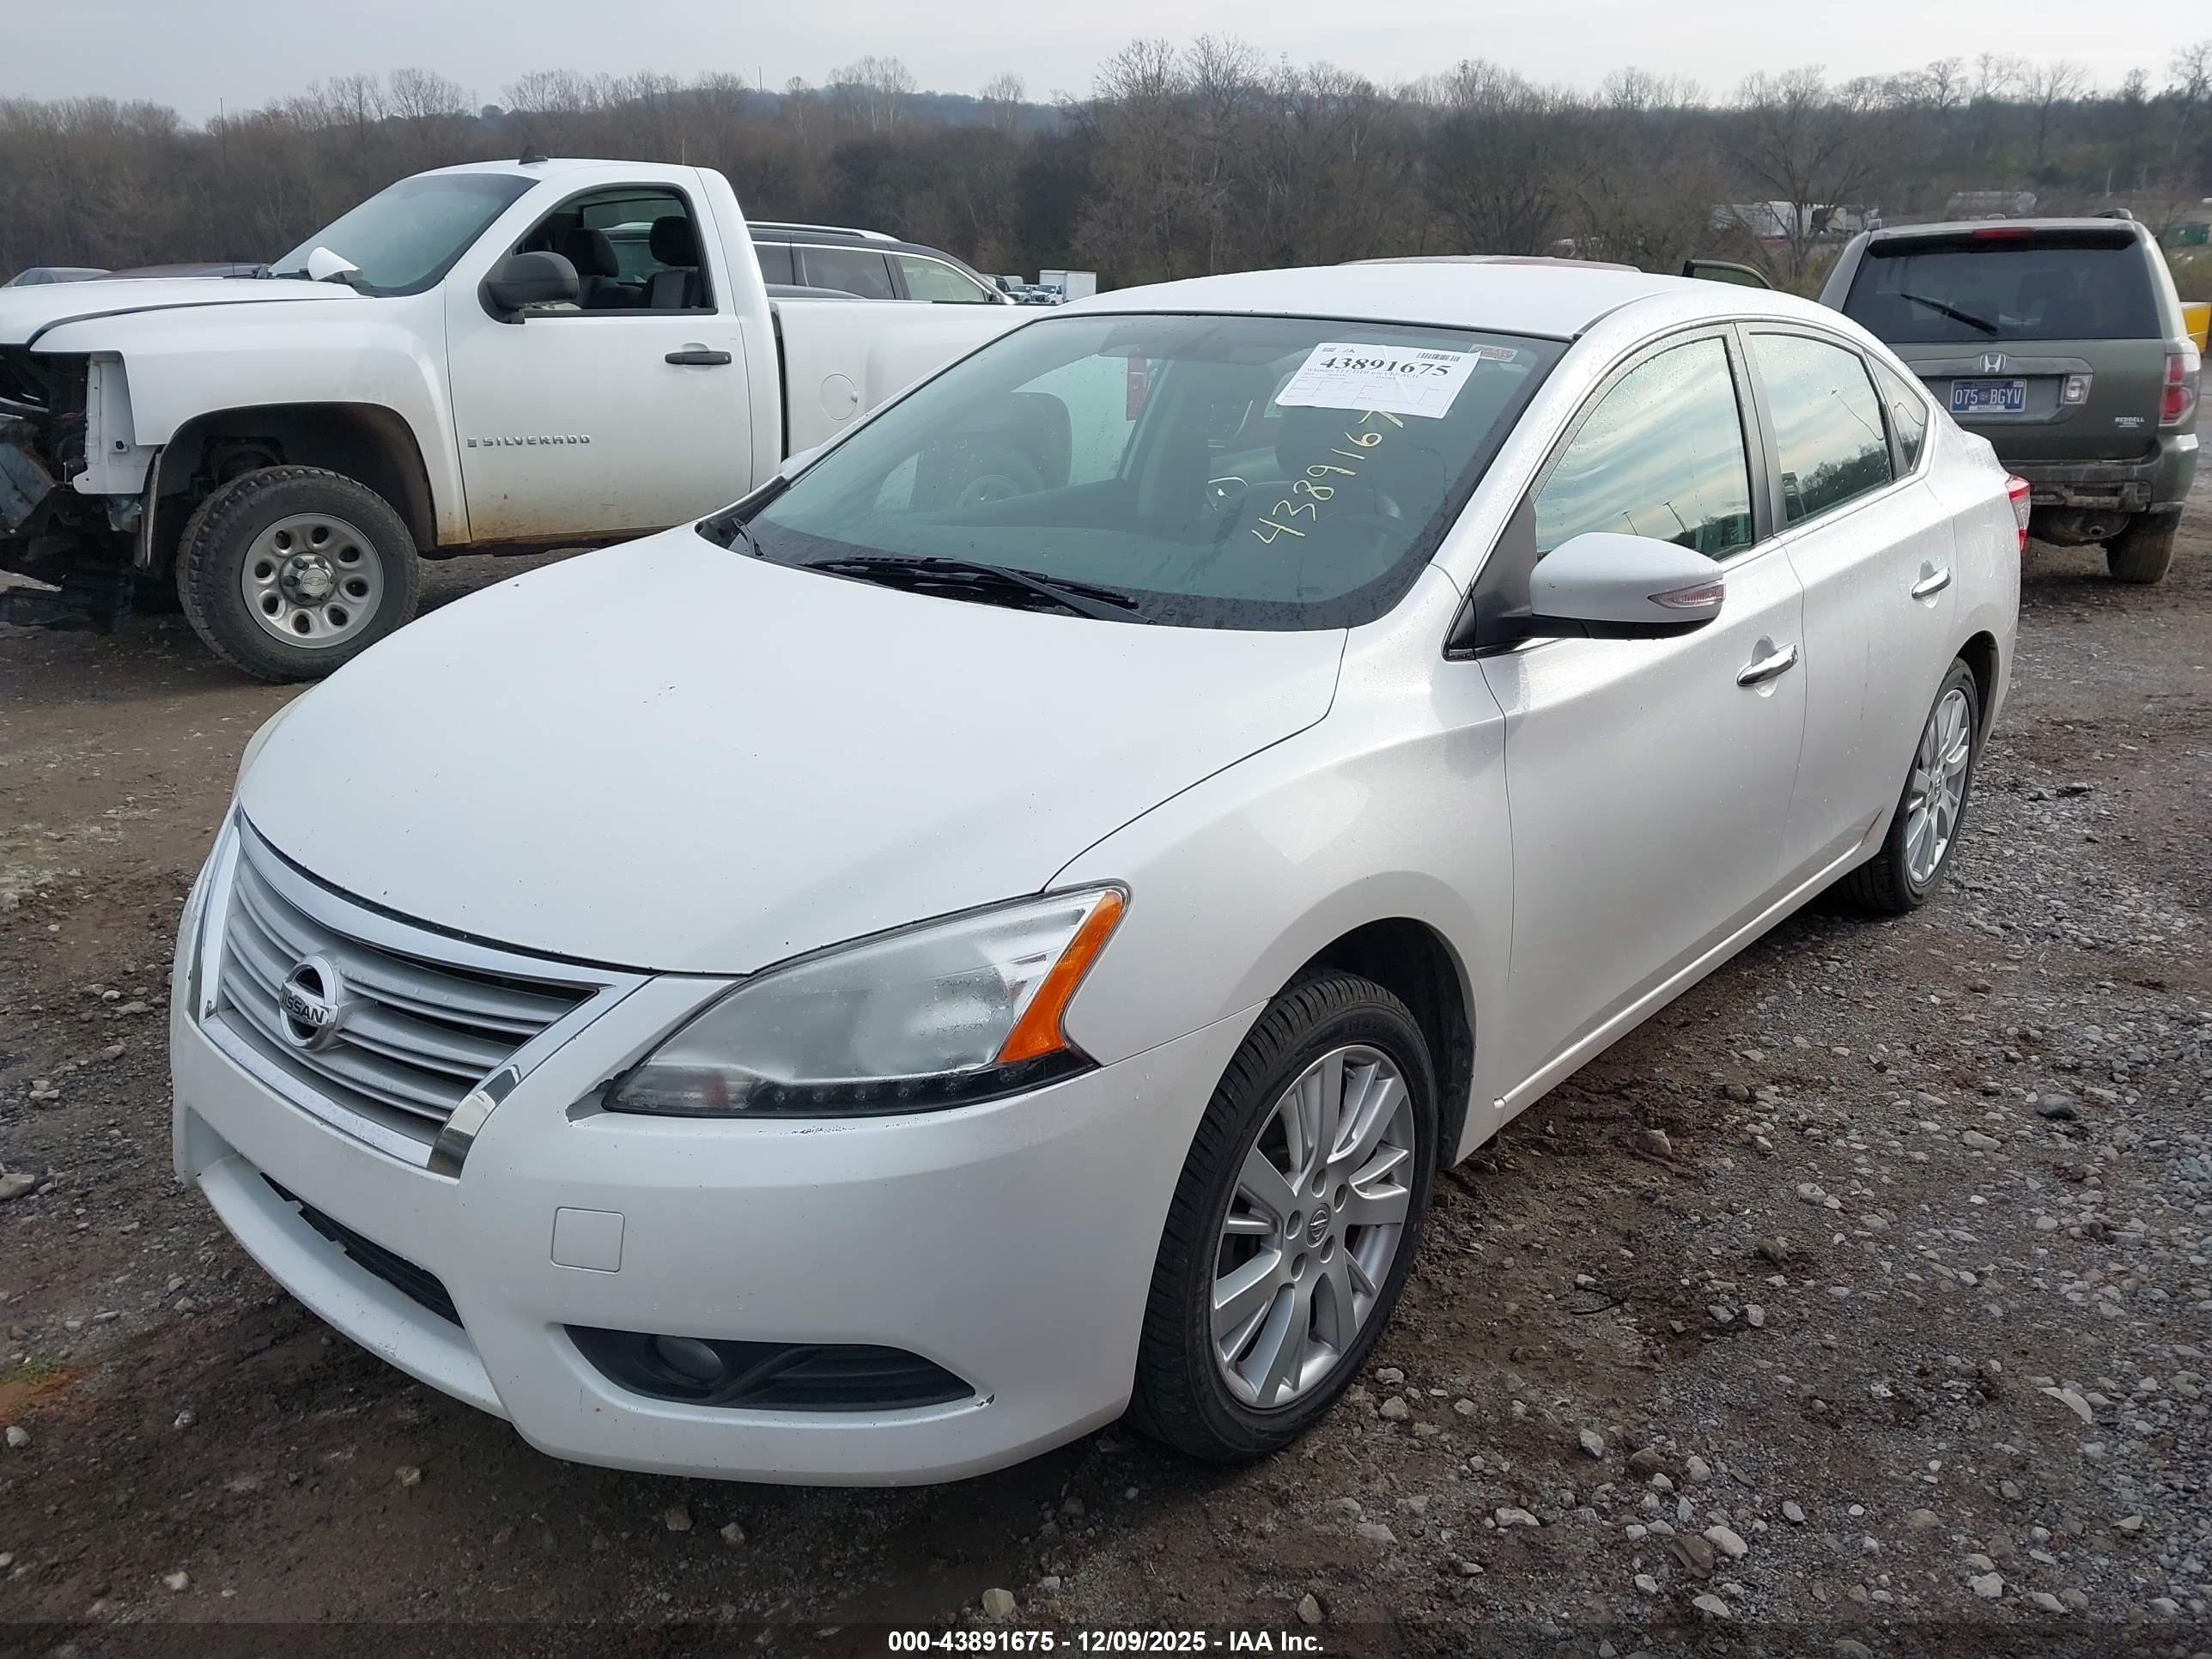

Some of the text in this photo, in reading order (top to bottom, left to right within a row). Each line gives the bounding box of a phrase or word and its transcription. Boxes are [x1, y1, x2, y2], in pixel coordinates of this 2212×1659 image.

[1321, 356, 1452, 377] 43891675
[1954, 388, 1978, 404] 075
[483, 434, 591, 447] SILVERADO
[281, 989, 325, 1024] NISSAN
